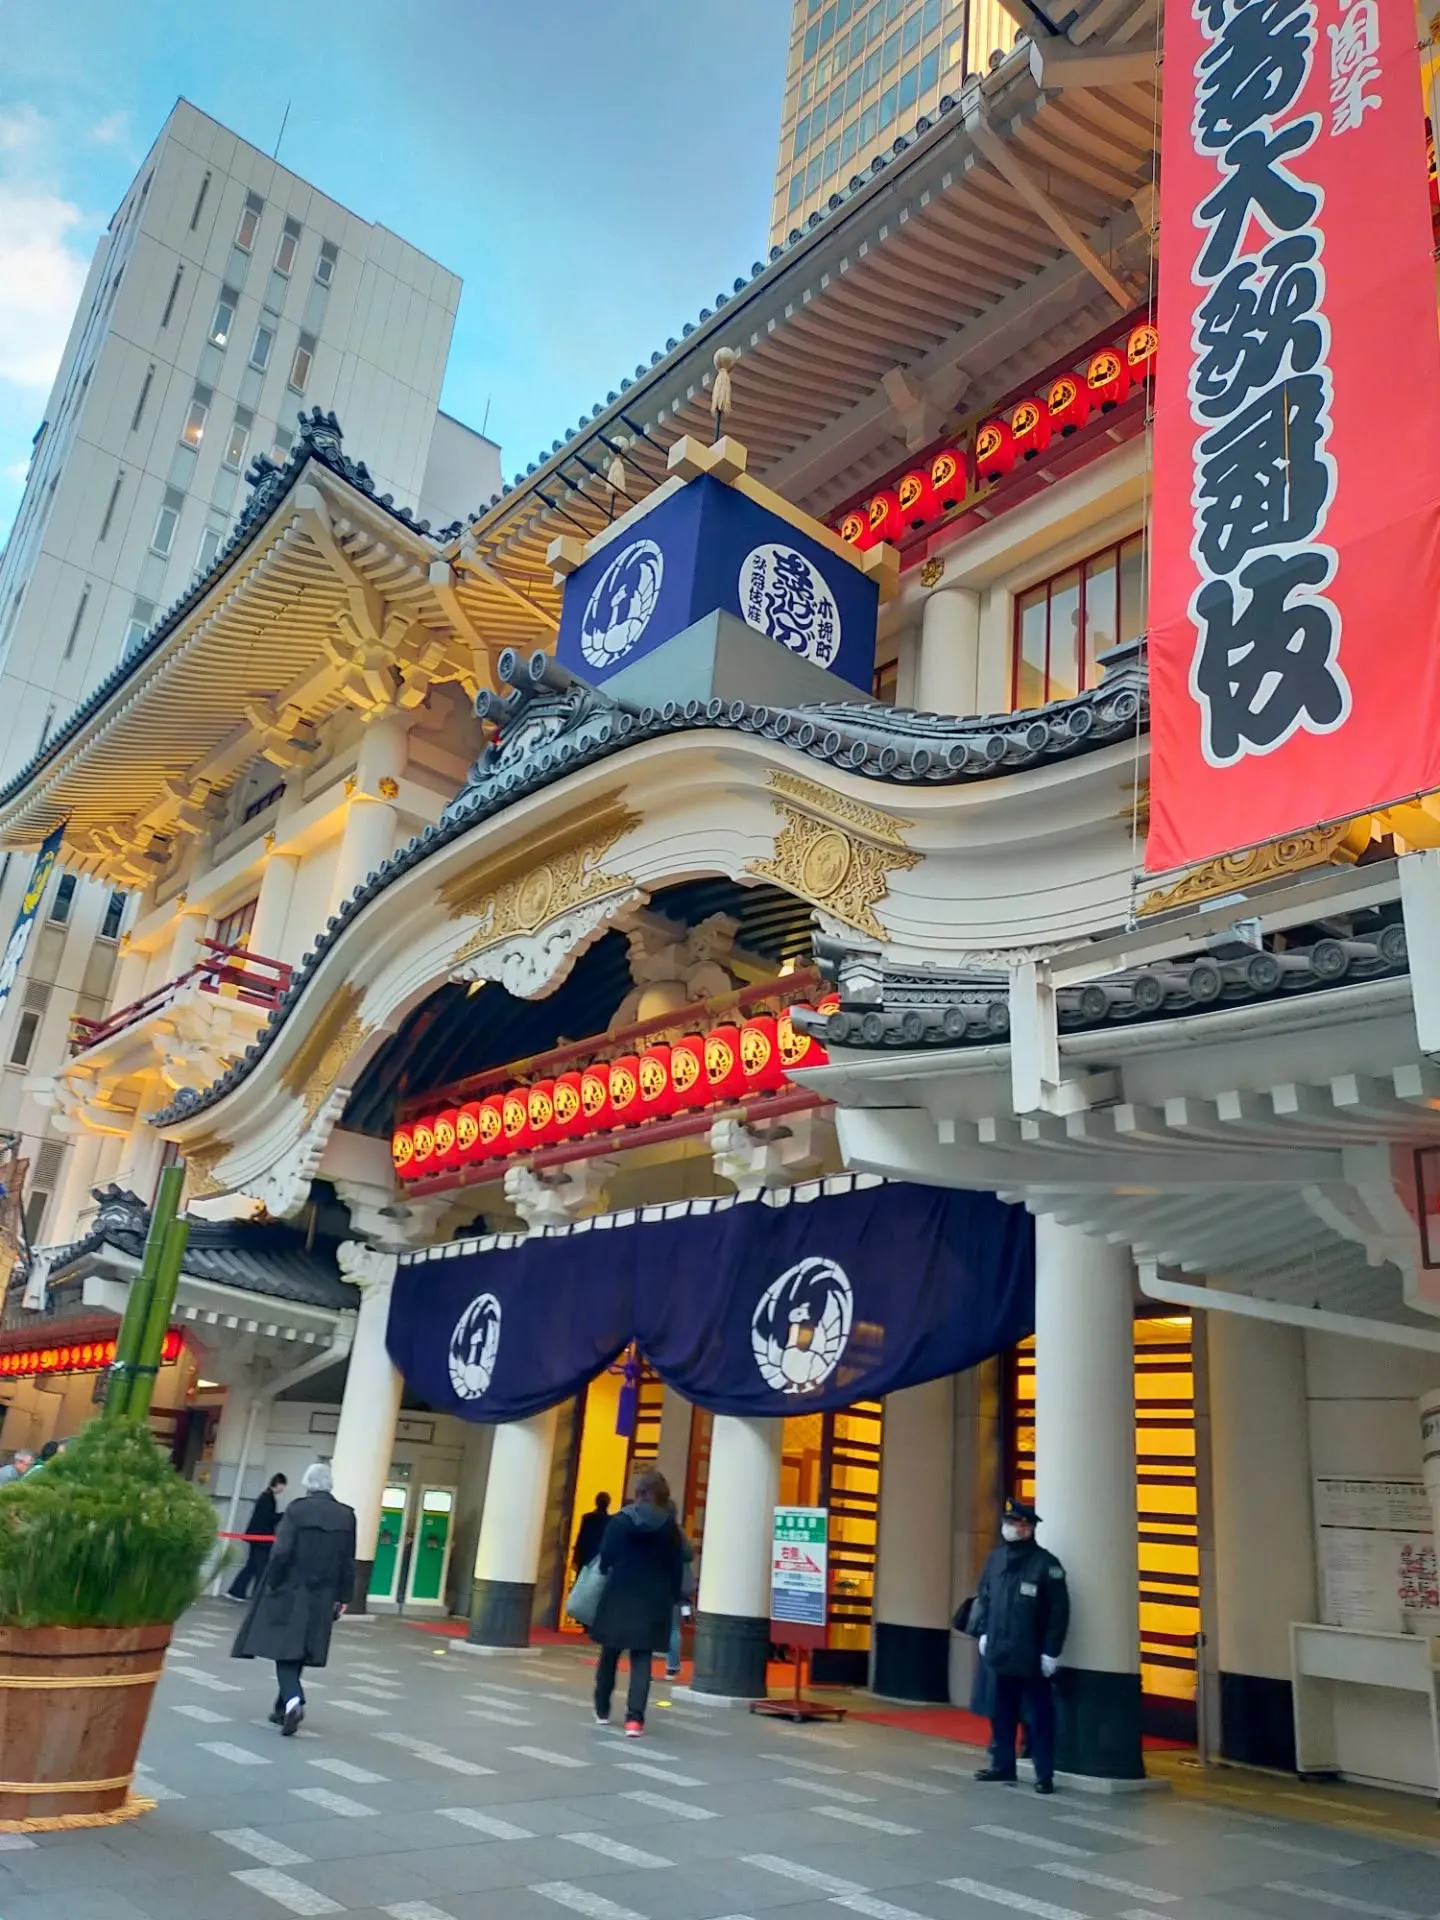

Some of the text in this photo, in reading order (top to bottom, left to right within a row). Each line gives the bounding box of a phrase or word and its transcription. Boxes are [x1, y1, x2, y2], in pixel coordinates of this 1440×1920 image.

[1190, 0, 1353, 769] 春大歌舞伎
